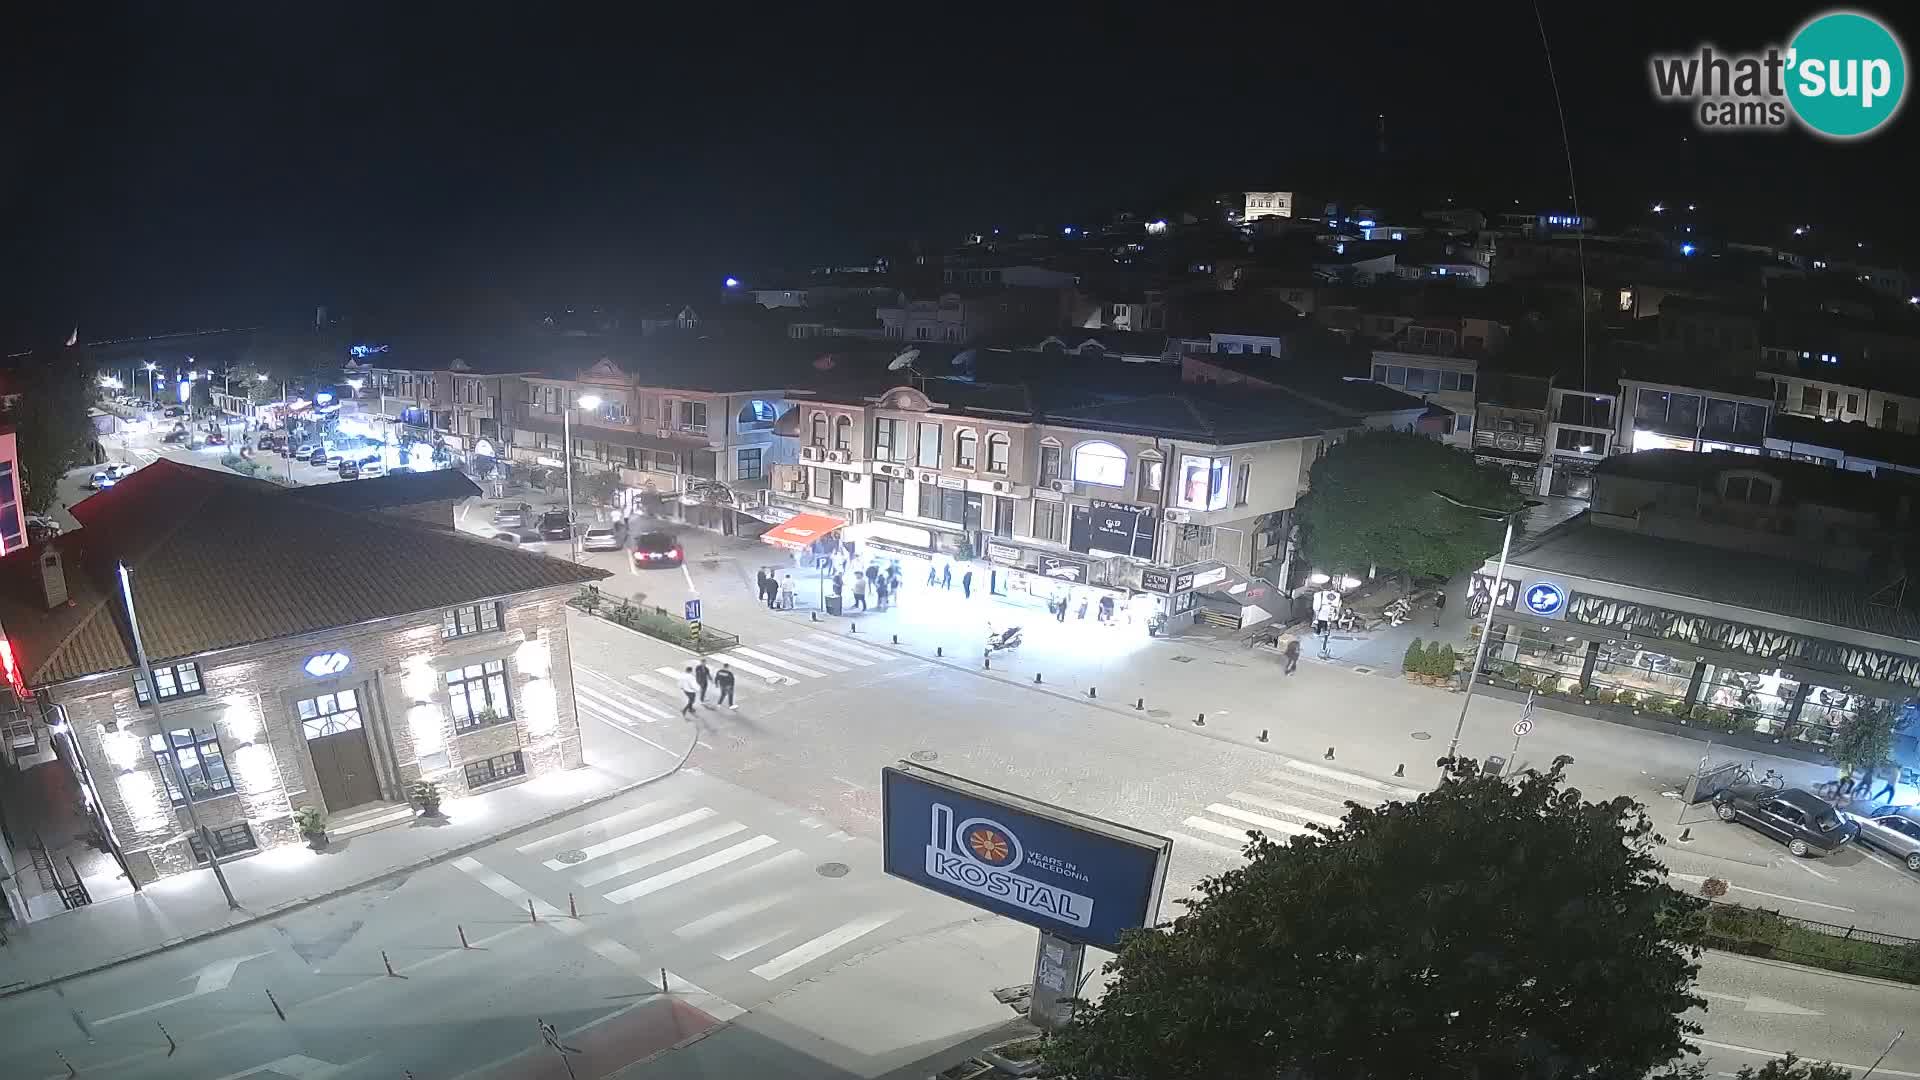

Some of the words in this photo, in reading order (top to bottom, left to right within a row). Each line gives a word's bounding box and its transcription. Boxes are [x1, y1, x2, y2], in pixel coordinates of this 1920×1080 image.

[931, 803, 1023, 868] 10
[1027, 857, 1089, 882] MACEDONIA
[1028, 850, 1063, 867] YEARS
[1065, 862, 1077, 871] IN
[935, 852, 1080, 921] KOSTAL
